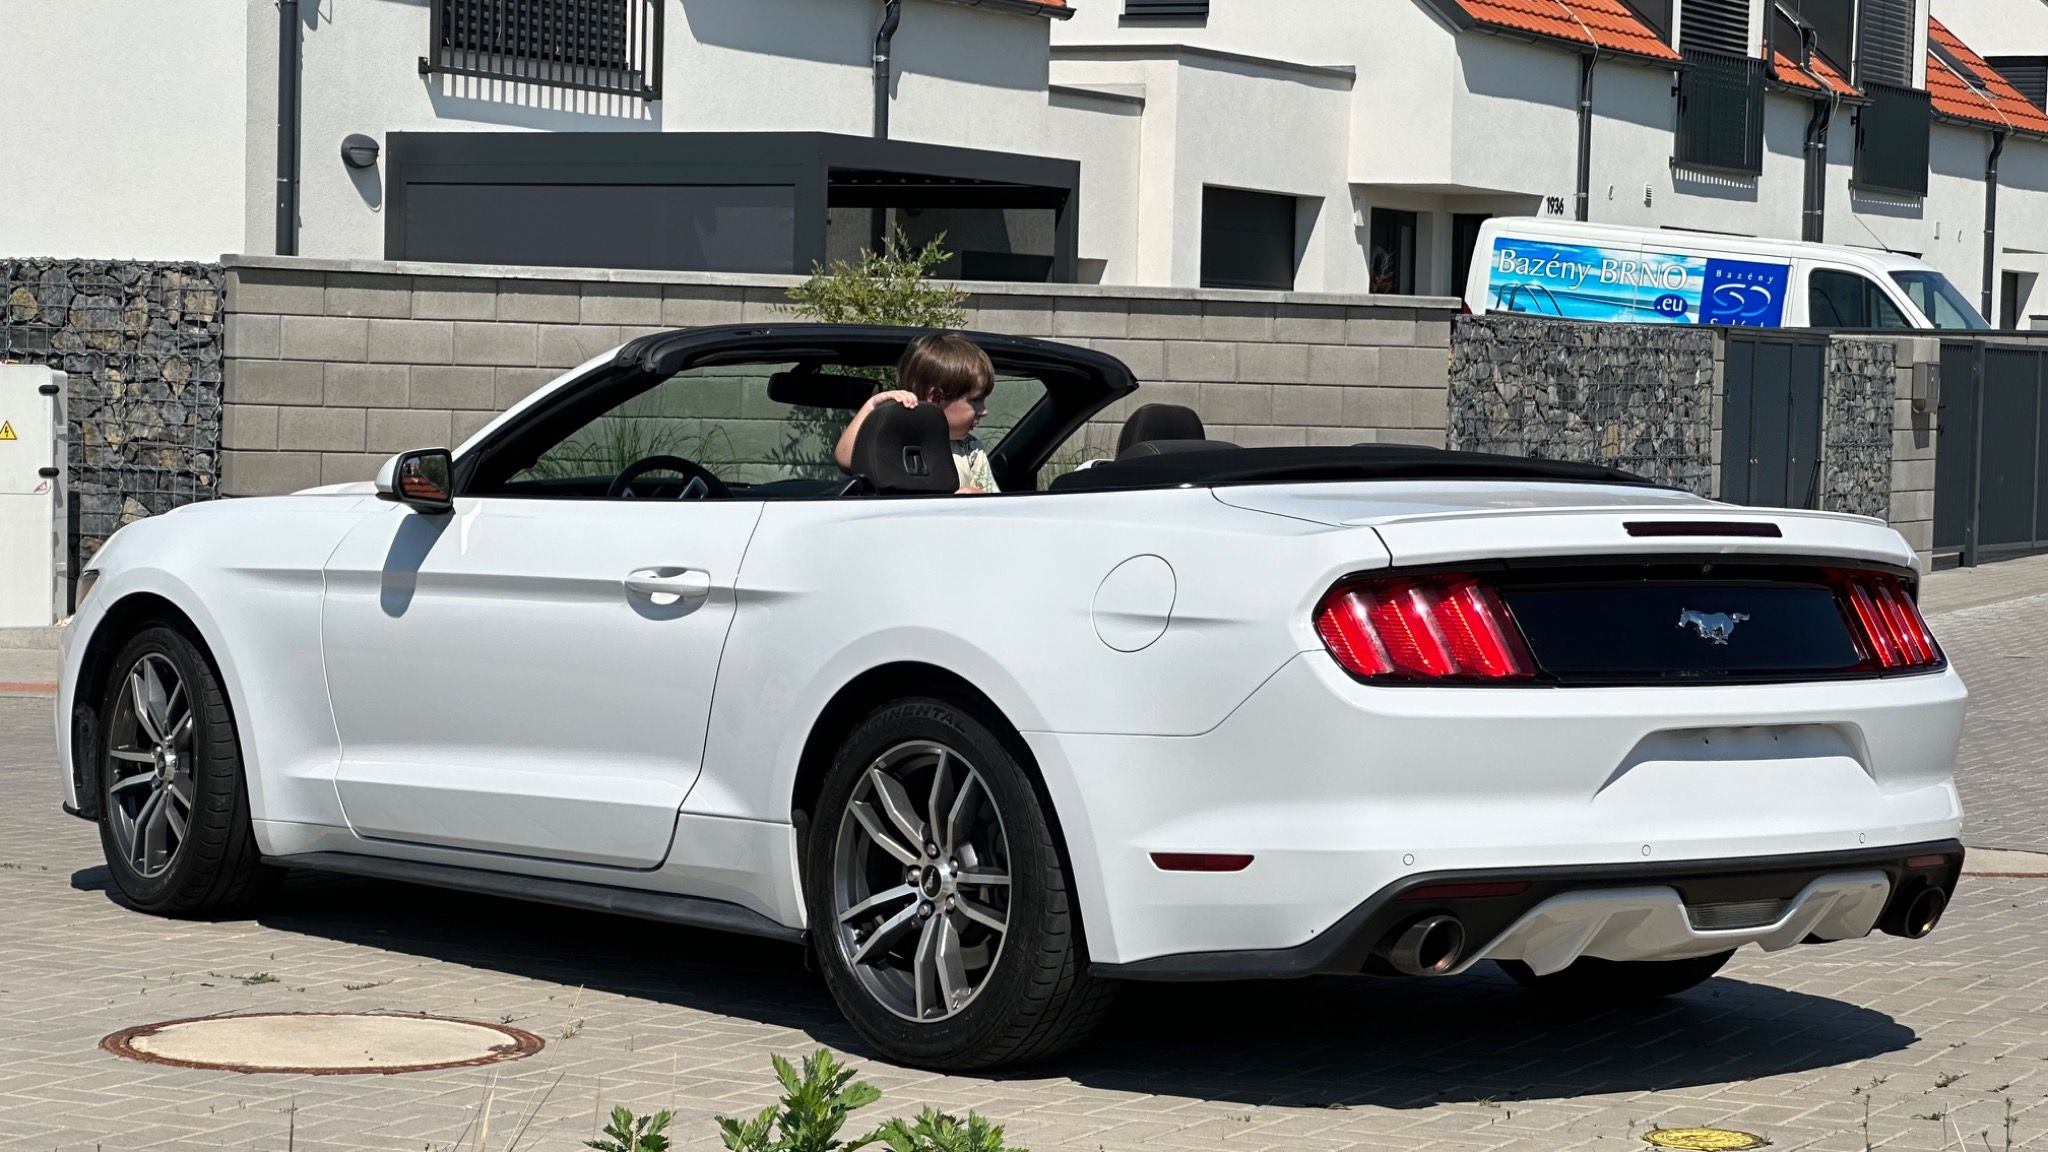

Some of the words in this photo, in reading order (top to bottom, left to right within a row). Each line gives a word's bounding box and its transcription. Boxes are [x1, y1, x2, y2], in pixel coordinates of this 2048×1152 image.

[1546, 196, 1564, 216] 1936
[1497, 248, 1592, 290] Bazény
[1600, 258, 1688, 290] BRNO
[1715, 269, 1774, 285] Bazény
[1655, 295, 1683, 312] .eu
